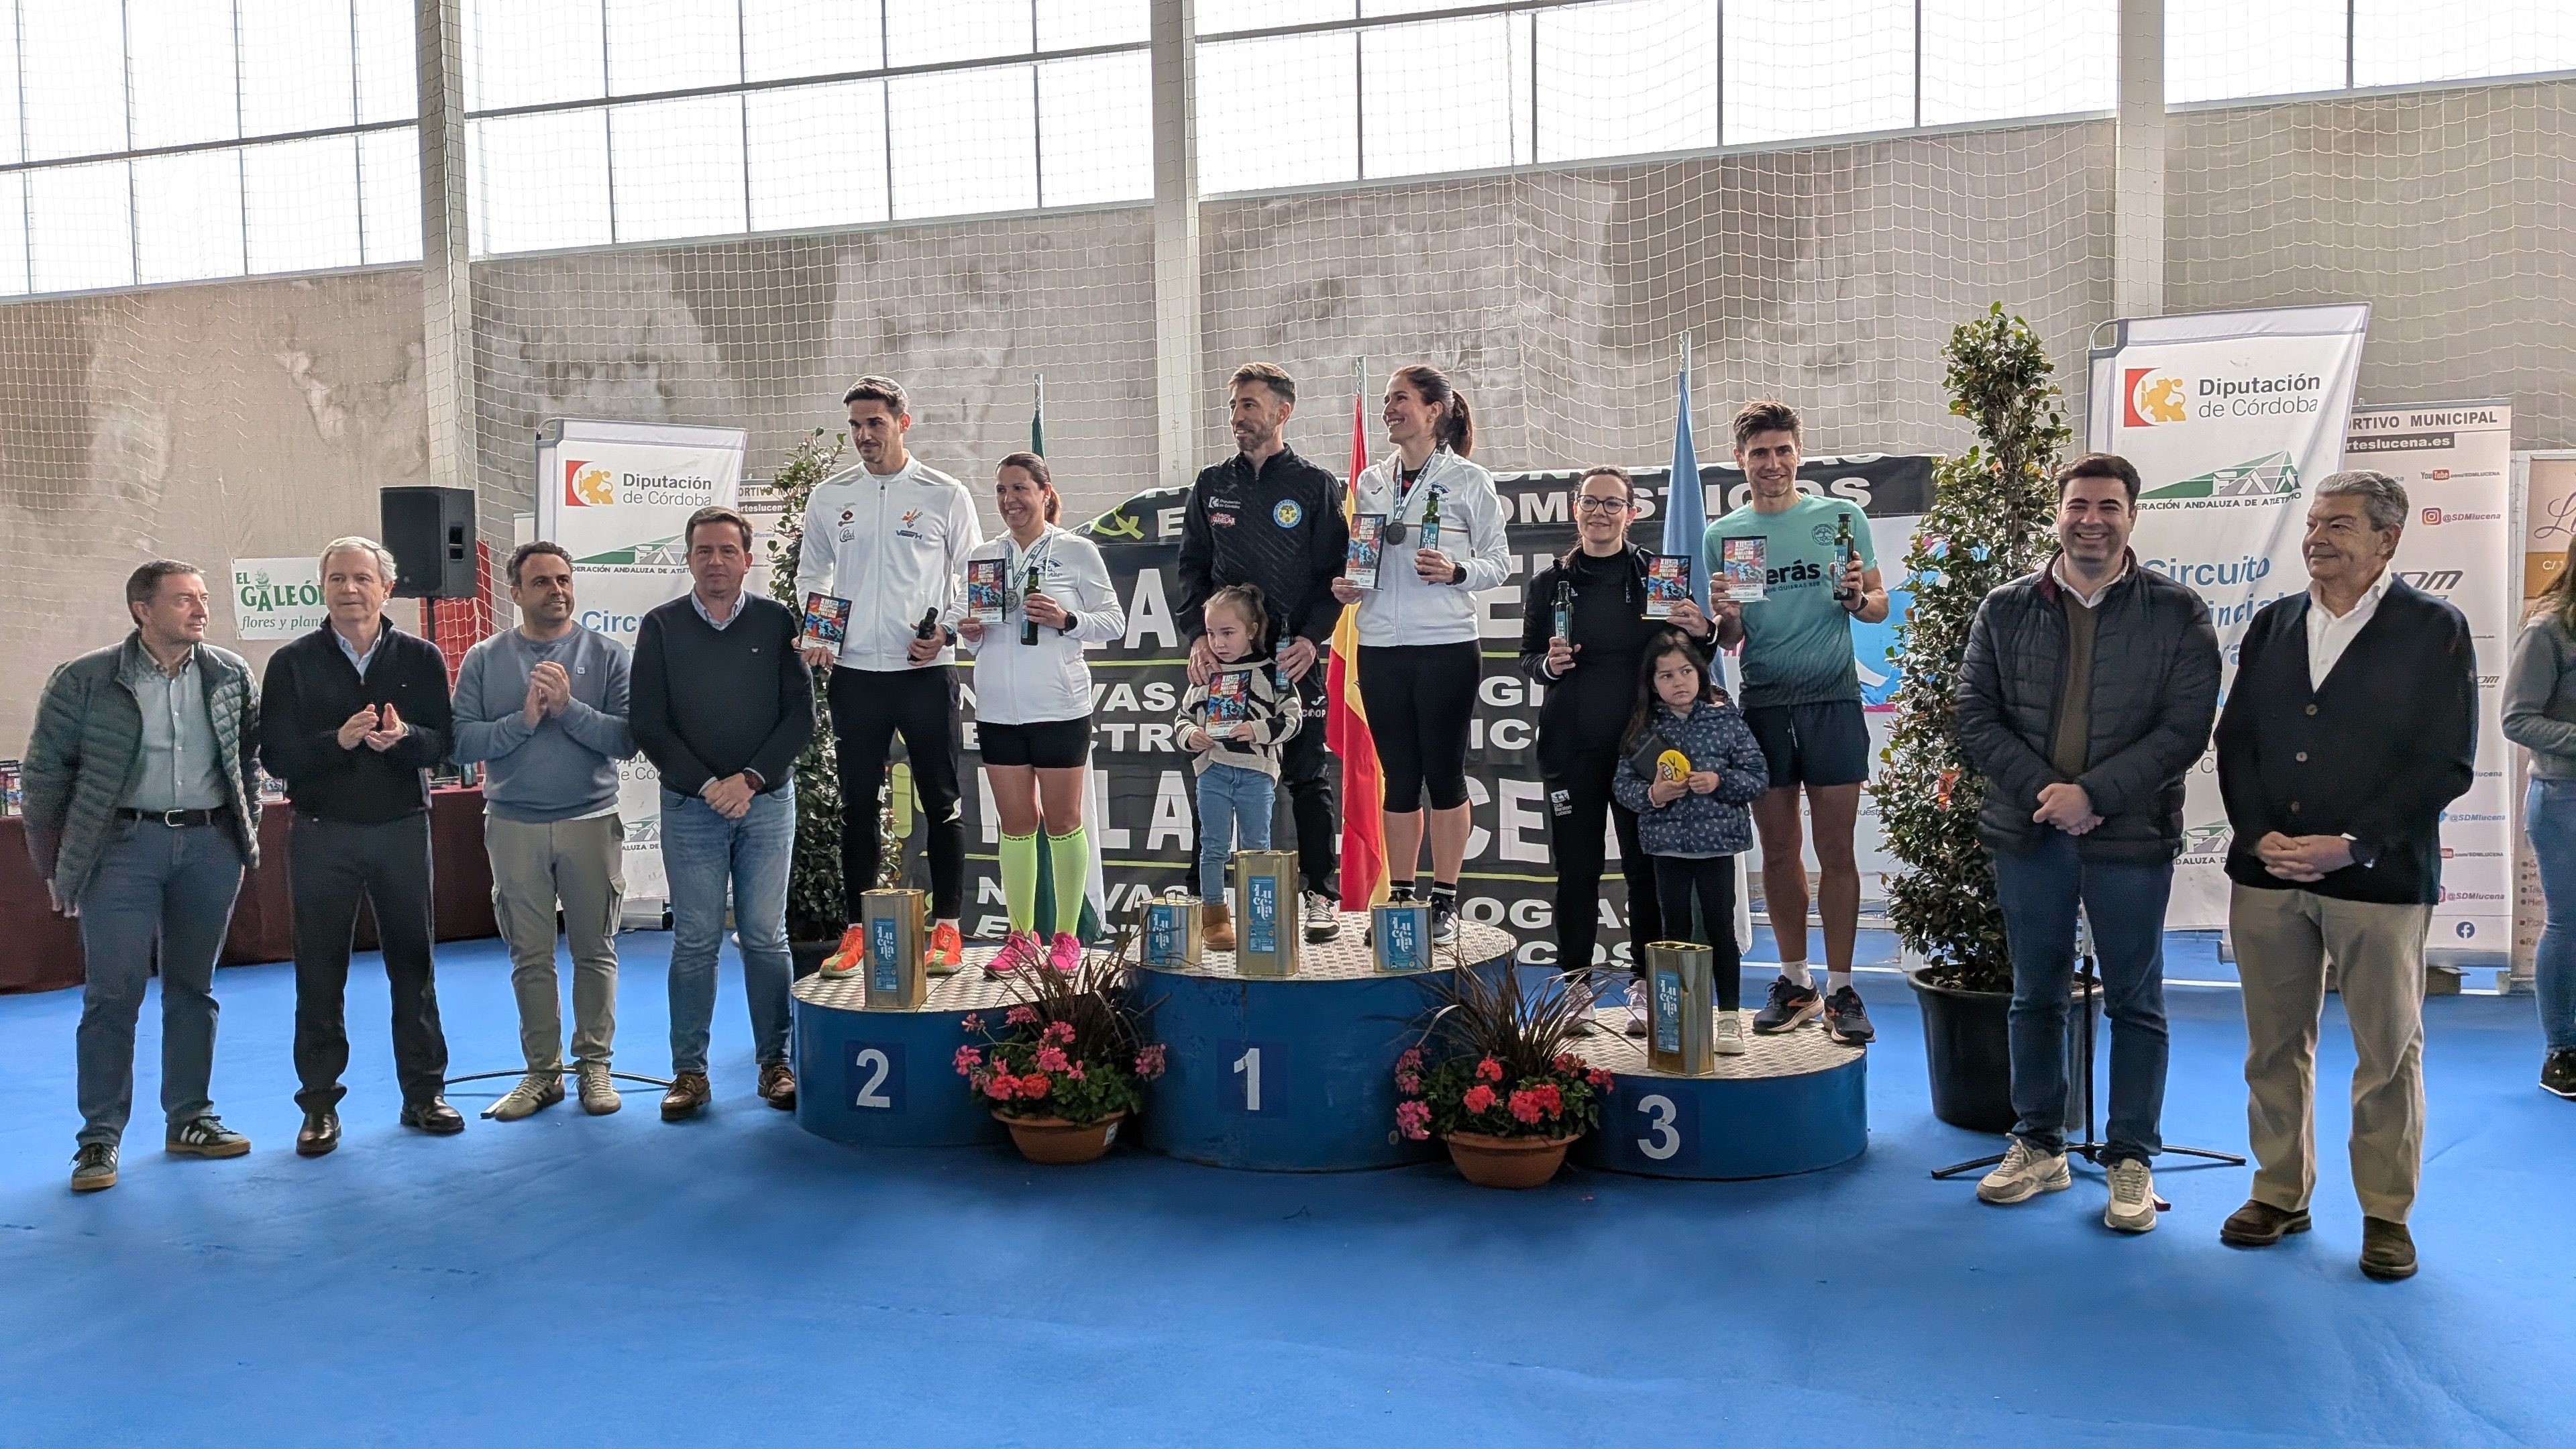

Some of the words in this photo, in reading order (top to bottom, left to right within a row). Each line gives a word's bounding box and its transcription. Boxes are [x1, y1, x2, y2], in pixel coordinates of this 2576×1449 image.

[2199, 373, 2320, 398] Diputación
[2198, 400, 2224, 418] de
[2232, 396, 2318, 417] Córdoba
[2410, 411, 2498, 427] MUNICIPAL
[2346, 437, 2451, 451] rteslucena.es
[623, 473, 712, 490] Diputación
[623, 490, 643, 504] de
[648, 491, 712, 506] Córdoba
[739, 487, 771, 497] ORTIVO
[2137, 499, 2180, 511] ERACIÓN
[2184, 500, 2241, 509] ANDALUZA
[2245, 498, 2257, 507] DE
[571, 565, 611, 574] DERACIÓN
[1766, 558, 1821, 585] erás
[235, 572, 250, 585] EL
[240, 615, 276, 631] flores
[278, 619, 288, 631] y
[582, 609, 643, 633] Circ
[622, 843, 647, 851] ALUZA
[2174, 857, 2216, 866] DALUZA
[856, 1049, 890, 1108] 2
[1234, 1048, 1260, 1110] 1
[1637, 1094, 1680, 1160] 3
